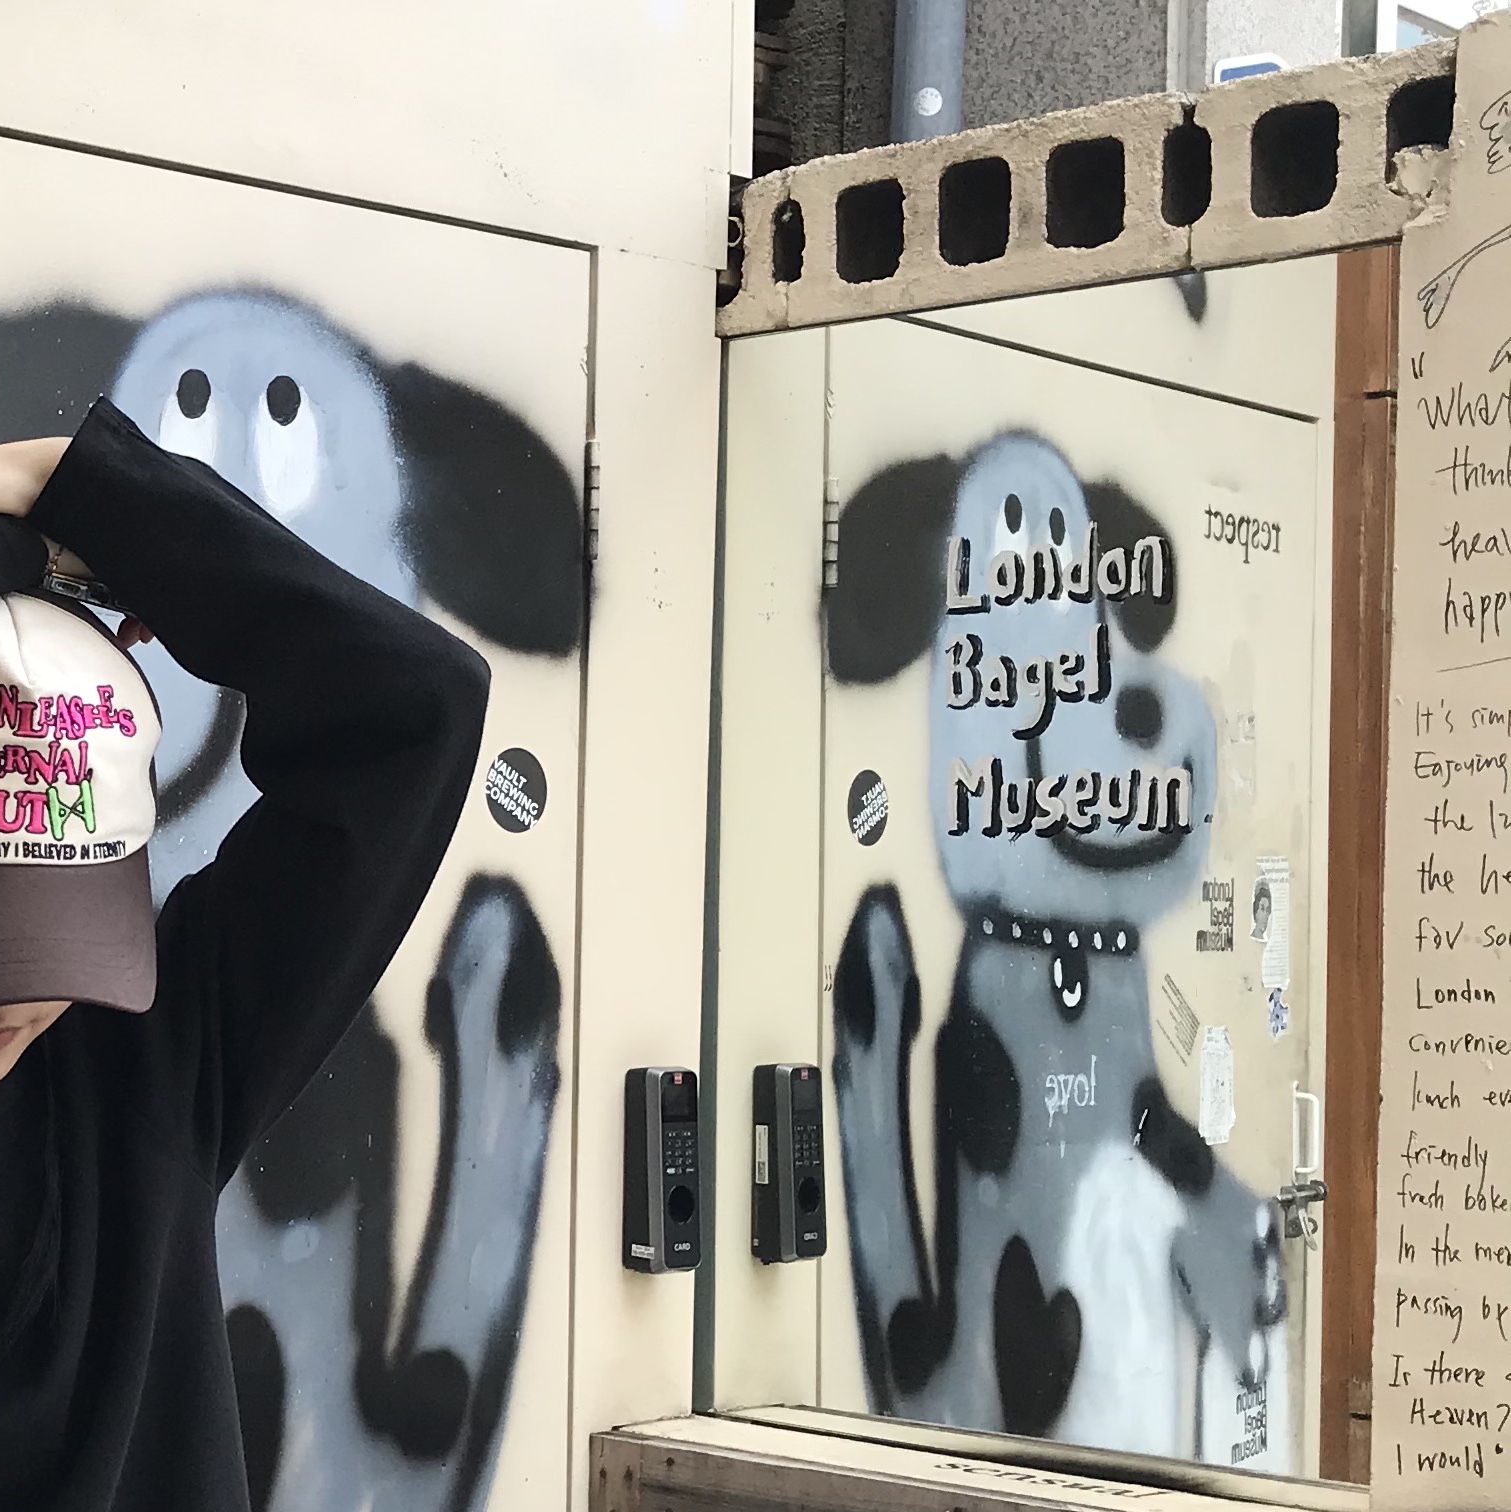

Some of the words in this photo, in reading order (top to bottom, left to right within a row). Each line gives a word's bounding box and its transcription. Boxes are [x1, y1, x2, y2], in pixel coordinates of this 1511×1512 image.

[945, 520, 1174, 615] London
[1445, 578, 1511, 643] happ
[945, 623, 1112, 740] Bagel
[493, 756, 528, 789] VAULT
[485, 781, 539, 829] COMPANY
[948, 755, 1195, 838] Museum
[1424, 798, 1474, 835] the
[22, 841, 77, 861] BELIEVED
[1417, 852, 1455, 894] the
[1416, 977, 1496, 1010] London
[1396, 1287, 1463, 1344] passing
[1423, 1350, 1486, 1388] there
[1410, 1398, 1510, 1432] Heaven?
